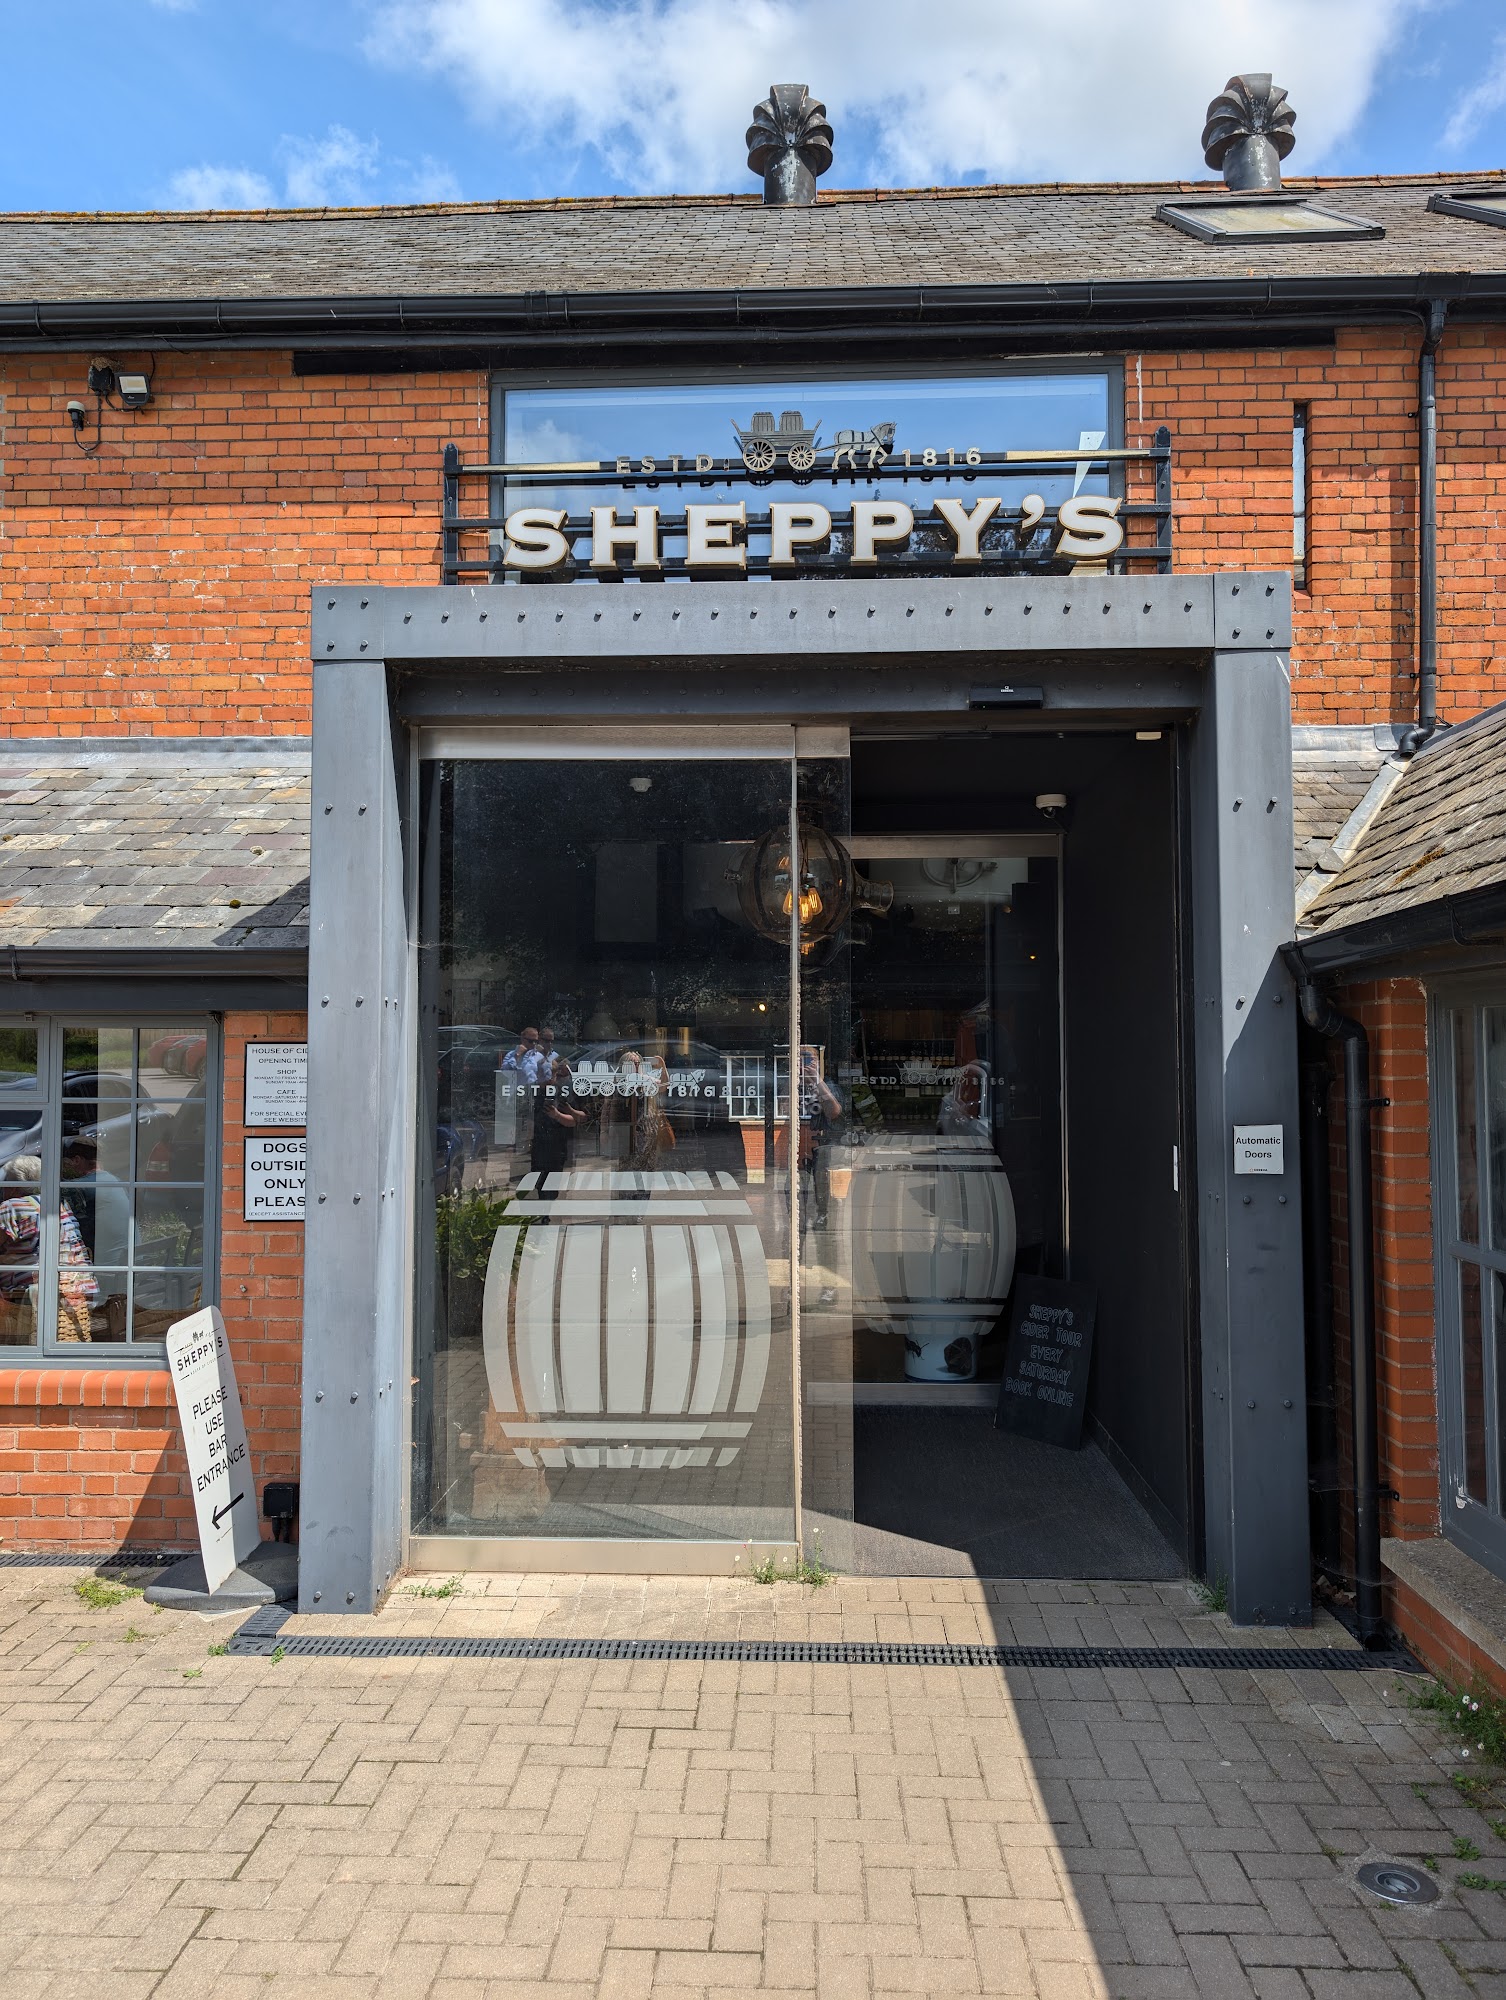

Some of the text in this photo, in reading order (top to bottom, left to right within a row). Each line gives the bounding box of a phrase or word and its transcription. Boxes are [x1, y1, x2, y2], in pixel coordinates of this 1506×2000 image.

[902, 447, 982, 466] 1816
[503, 494, 1124, 571] SHEPPY'S
[263, 1142, 307, 1153] DOGS
[1235, 1136, 1281, 1145] Automatic
[250, 1160, 306, 1171] OUTSID
[1244, 1150, 1272, 1159] Doors
[264, 1178, 306, 1189] ONLY
[254, 1196, 306, 1207] PLEAS
[1020, 1320, 1083, 1348] CIDER TOUR
[177, 1336, 223, 1371] SHEPPY'S
[1030, 1344, 1064, 1364] EVERY
[1018, 1360, 1071, 1386] SATURDAY
[192, 1385, 228, 1420] PLEASE
[1004, 1376, 1074, 1408] BOOK ONLINE
[205, 1411, 224, 1435] USE
[208, 1433, 228, 1458] BAR
[196, 1443, 246, 1493] ENTRANCE
